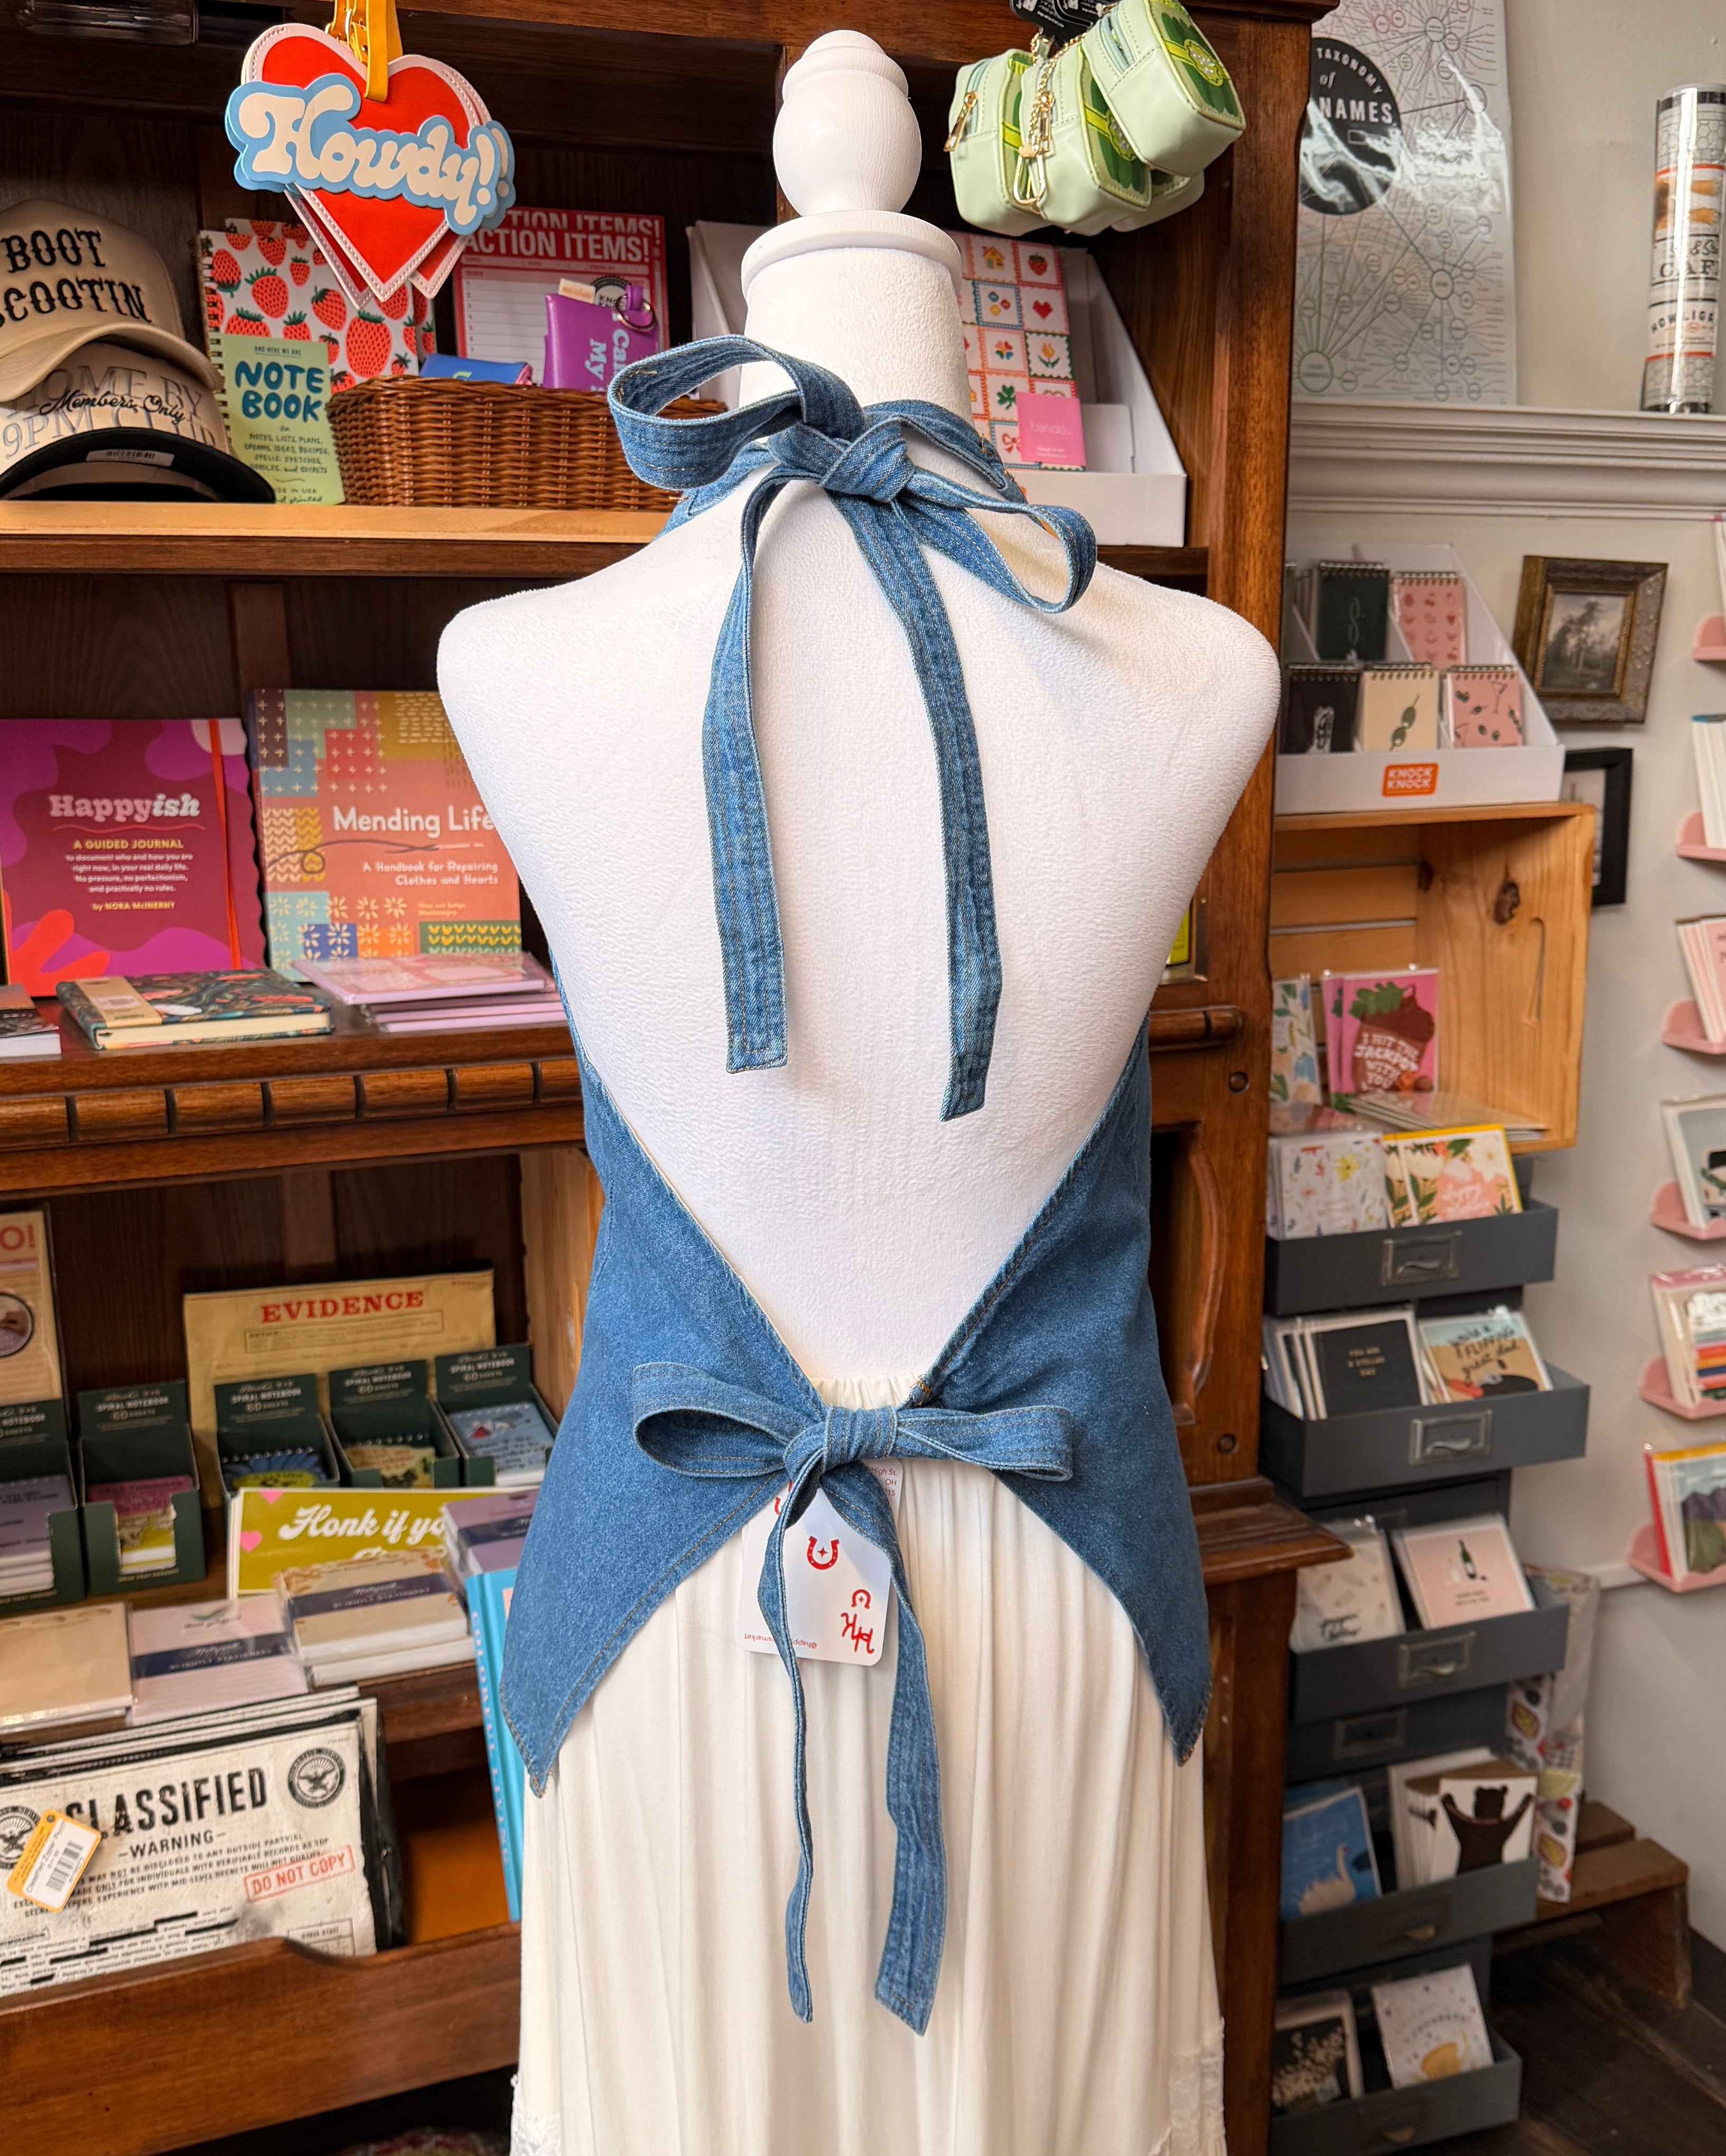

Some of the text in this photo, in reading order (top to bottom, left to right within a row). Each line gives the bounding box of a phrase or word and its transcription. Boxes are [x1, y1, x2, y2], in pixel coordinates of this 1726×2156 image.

[1317, 48, 1383, 94] TAXONOMY
[1319, 71, 1337, 89] of
[1319, 97, 1393, 124] NAMES
[239, 84, 494, 225] Howdy!
[1, 228, 106, 273] BOOT
[564, 232, 649, 263] ITEMS!
[0, 277, 151, 327] COOTIN
[585, 339, 607, 380] My
[236, 361, 324, 393] NOTE
[41, 390, 185, 423] Members Only
[161, 377, 202, 420] BY
[242, 390, 323, 423] BOOK
[3, 403, 95, 459] 9PM
[1387, 779, 1432, 789] KNOCK
[1389, 766, 1434, 779] KNOCK
[49, 793, 200, 822] Happyish
[333, 805, 496, 838] Mending Life
[73, 839, 183, 849] A GUIDED JOURNAL
[363, 860, 498, 873] A Handbook for Repairing
[396, 875, 498, 886] Clothes and Hearts
[92, 903, 104, 911] by
[105, 902, 130, 910] NORA
[1354, 1044, 1419, 1072] JACKPOT
[261, 1291, 424, 1324] EVIDENCE
[96, 1402, 124, 1413] SPIRAL
[126, 1395, 169, 1408] NOTEBOOK
[245, 1402, 262, 1412] 60
[260, 1388, 302, 1401] NOTEBOOK
[113, 1410, 128, 1421] 60
[889, 1468, 898, 1476] St.
[278, 1504, 379, 1540] Honk
[382, 1509, 409, 1545] if
[130, 1830, 213, 1859] WARNING
[95, 1882, 116, 1893] ONLY
[119, 1878, 134, 1887] FOR
[137, 1867, 190, 1883] INDIVIDUALS
[192, 1861, 214, 1872] WITH
[216, 1852, 261, 1868] VERIFIABLE
[264, 1844, 299, 1858] RECORDS
[314, 1837, 329, 1848] TOP
[110, 1869, 127, 1879] NOT
[144, 1857, 190, 1871] DISCLOSED
[207, 1847, 223, 1857] ANY
[227, 1842, 261, 1854] OUTSIDE
[251, 1853, 346, 1896] DO NOT COPY
[97, 1888, 145, 1903] EXPERIENCE
[148, 1881, 170, 1892] WITH
[213, 1866, 249, 1878] SECRETS
[251, 1862, 269, 1871] WILL
[271, 1858, 287, 1867] NOT
